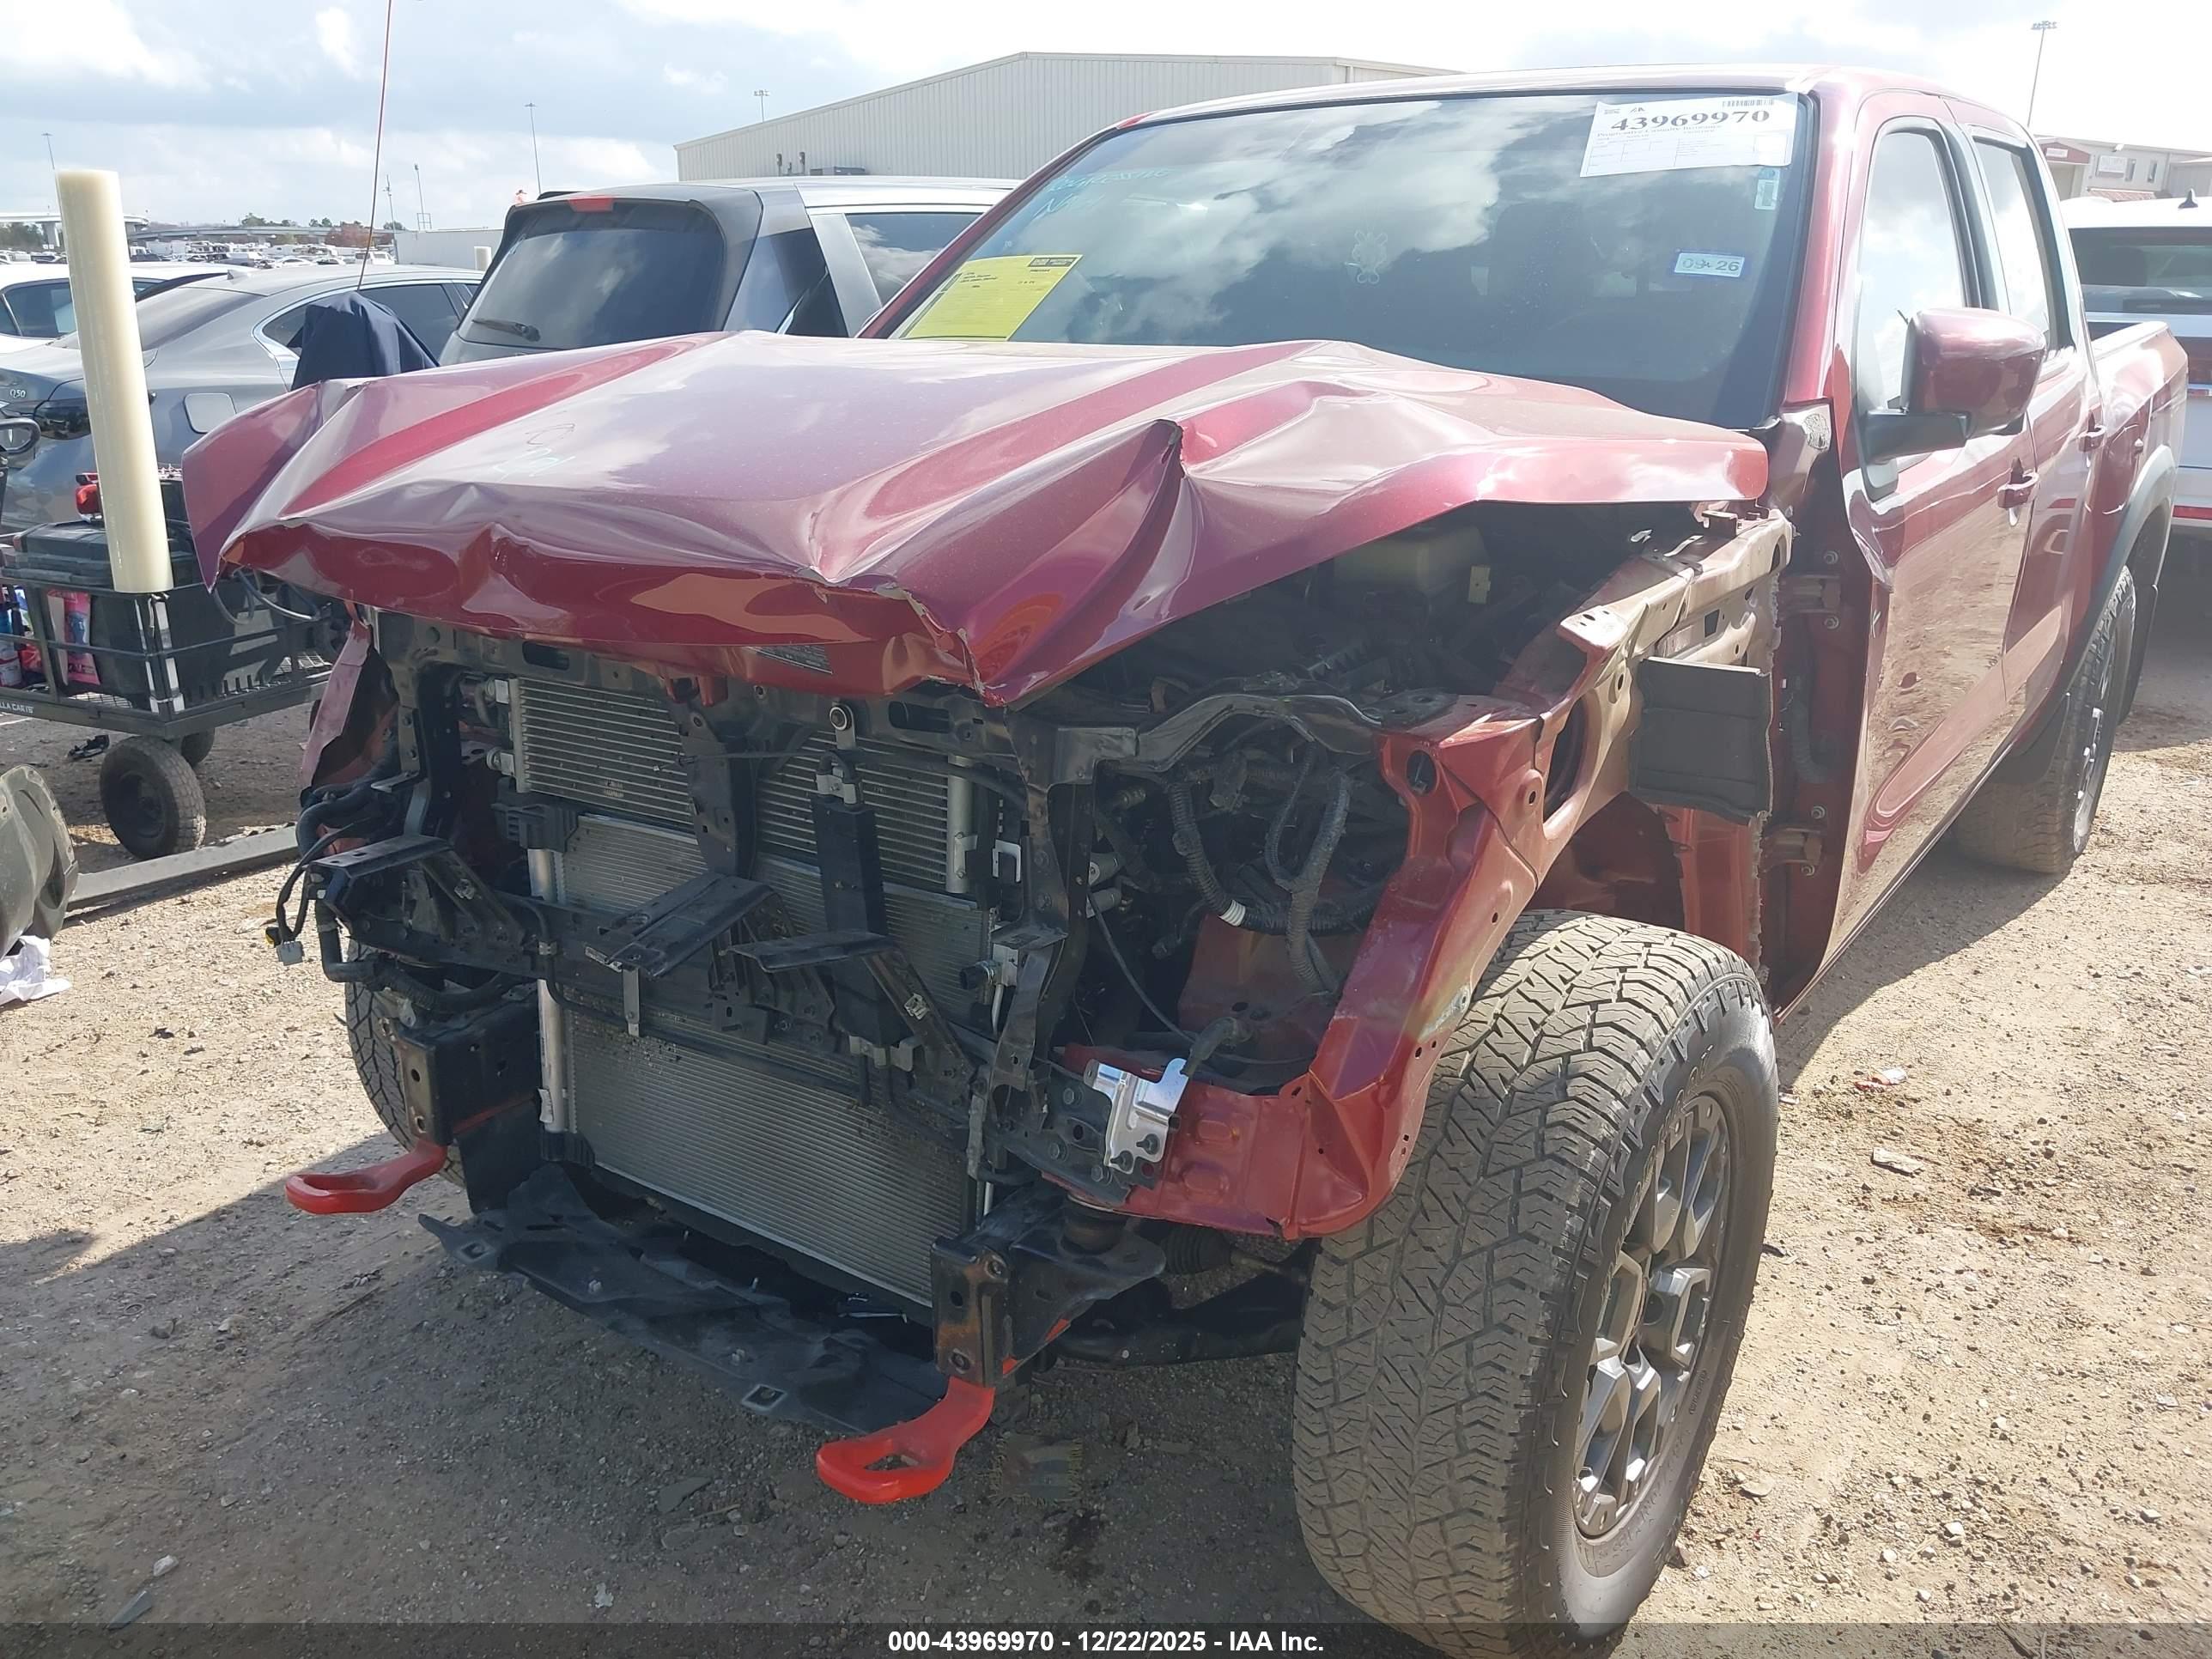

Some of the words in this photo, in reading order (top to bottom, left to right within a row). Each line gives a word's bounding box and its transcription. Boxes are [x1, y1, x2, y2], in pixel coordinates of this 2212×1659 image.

[1611, 110, 1770, 131] 43969970
[1716, 260, 1741, 271] 26
[9, 388, 27, 398] Q50
